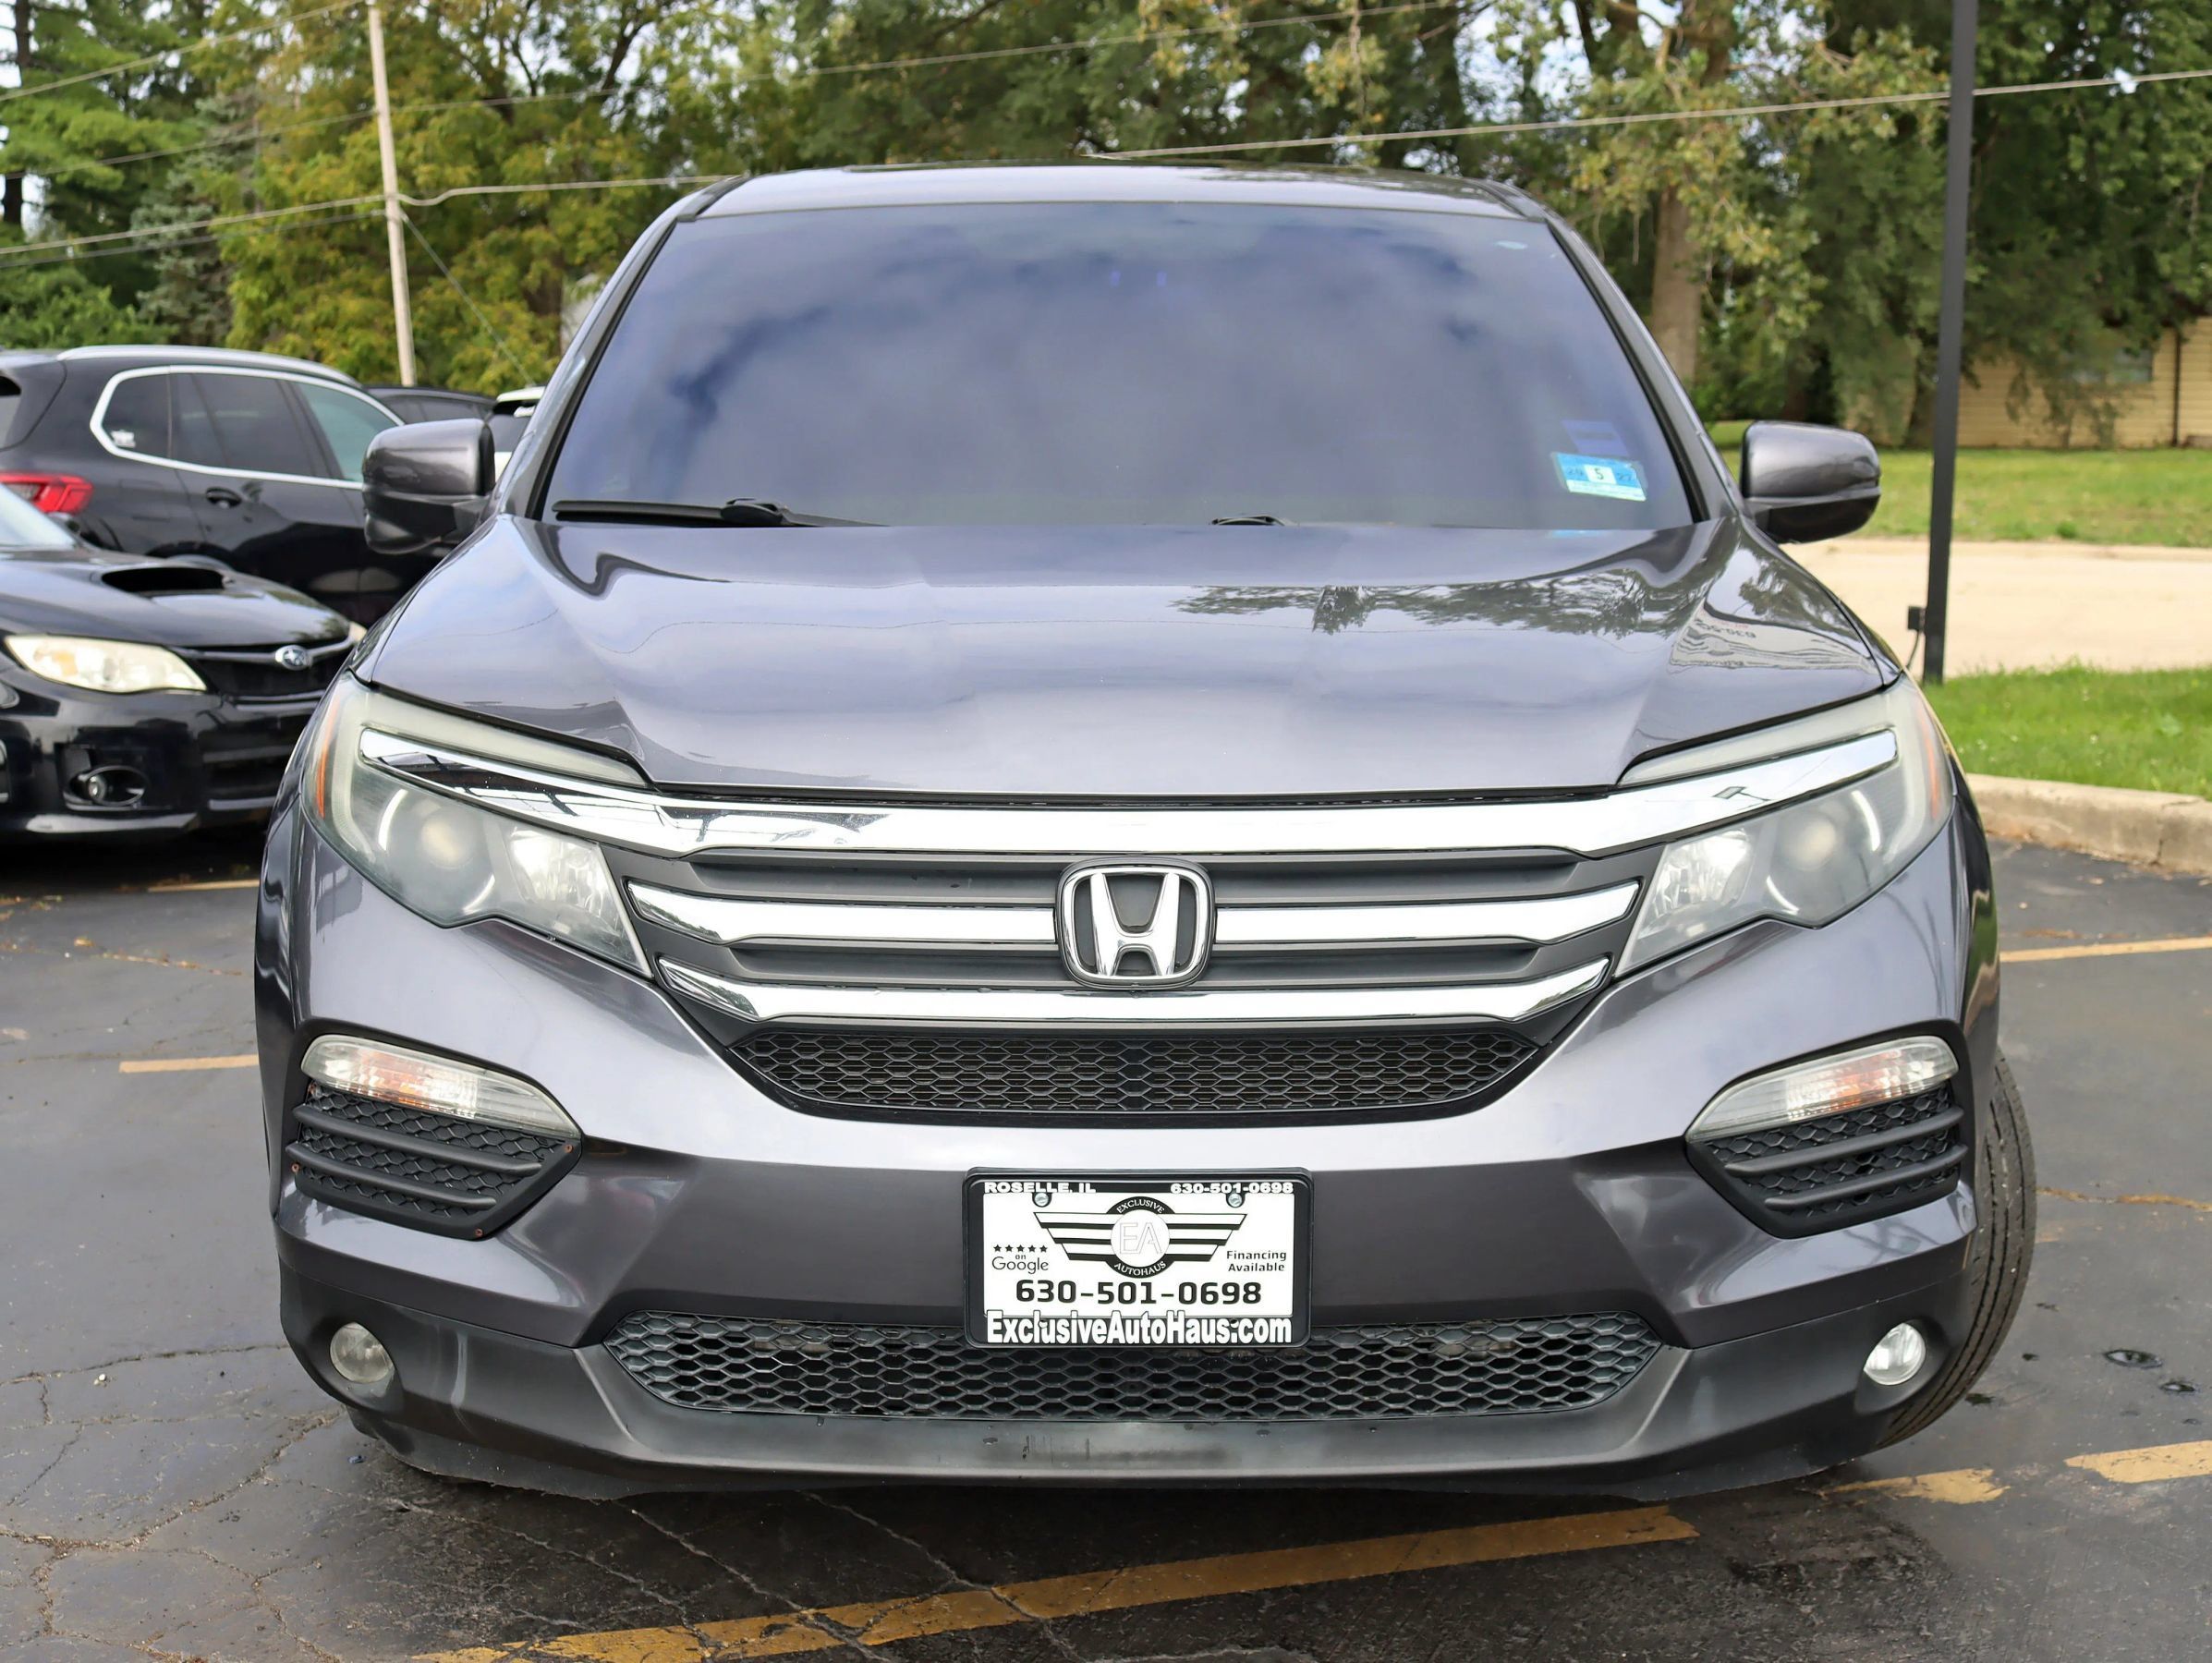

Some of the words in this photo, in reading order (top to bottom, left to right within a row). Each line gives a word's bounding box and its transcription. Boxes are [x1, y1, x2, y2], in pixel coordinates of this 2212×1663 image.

[984, 1182, 1073, 1194] ROSELLE,
[1078, 1183, 1097, 1194] IL
[1170, 1182, 1294, 1194] 630-501-0698
[1115, 1197, 1165, 1214] EXCLUSIVE
[1226, 1250, 1287, 1261] Financing
[991, 1256, 1050, 1275] Google
[1113, 1260, 1167, 1277] AUTOHAUS
[1227, 1262, 1285, 1272] Available
[1015, 1279, 1262, 1305] 630-501-0698
[986, 1309, 1293, 1344] ExclusiveAutoHaus.com
